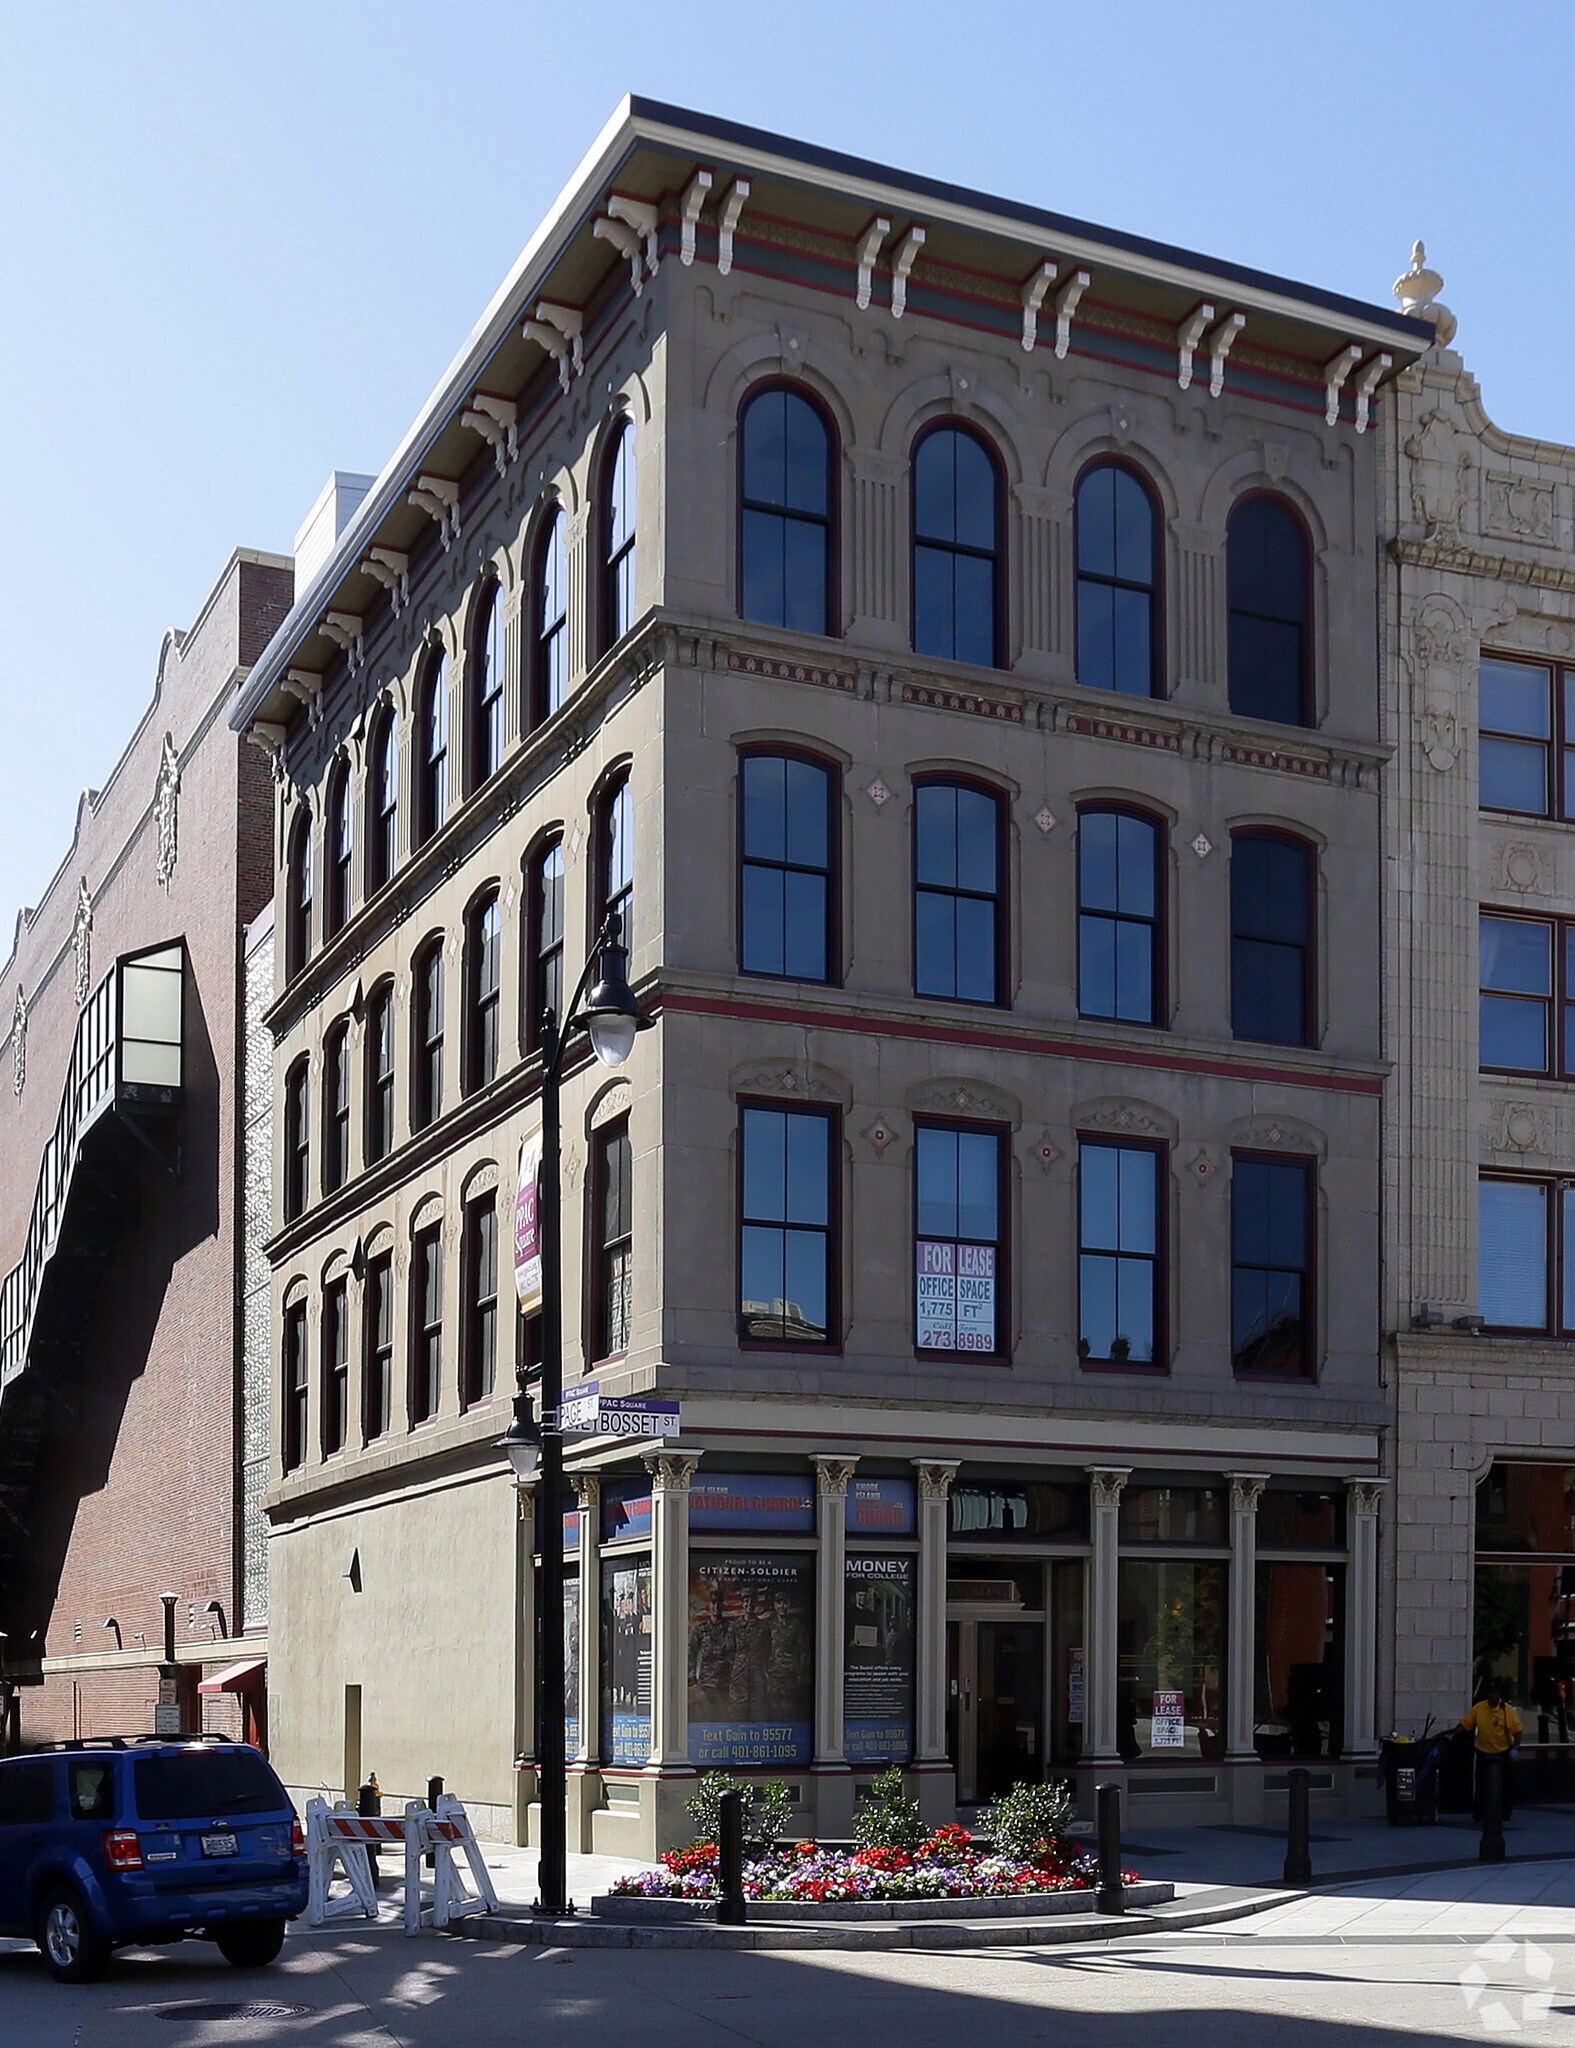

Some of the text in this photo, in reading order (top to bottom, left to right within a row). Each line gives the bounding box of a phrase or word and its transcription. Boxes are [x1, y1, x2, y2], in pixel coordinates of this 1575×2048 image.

[515, 1197, 534, 1232] PPAC
[924, 1244, 993, 1276] FOR LEASE
[919, 1276, 990, 1299] OFFICE SPACE
[920, 1301, 953, 1316] 1,775
[932, 1321, 978, 1332] Call Tom
[560, 1401, 582, 1427] PAGE
[698, 1566, 798, 1576] CITIZEN-SOLDIER
[846, 1560, 909, 1573] MONEY
[1159, 1694, 1177, 1704] FOR
[1155, 1705, 1182, 1716] LEASE
[1155, 1718, 1181, 1726] OFFICE
[701, 1728, 793, 1742] Text Gain to 95577
[698, 1744, 797, 1759] or call 401-861-1095
